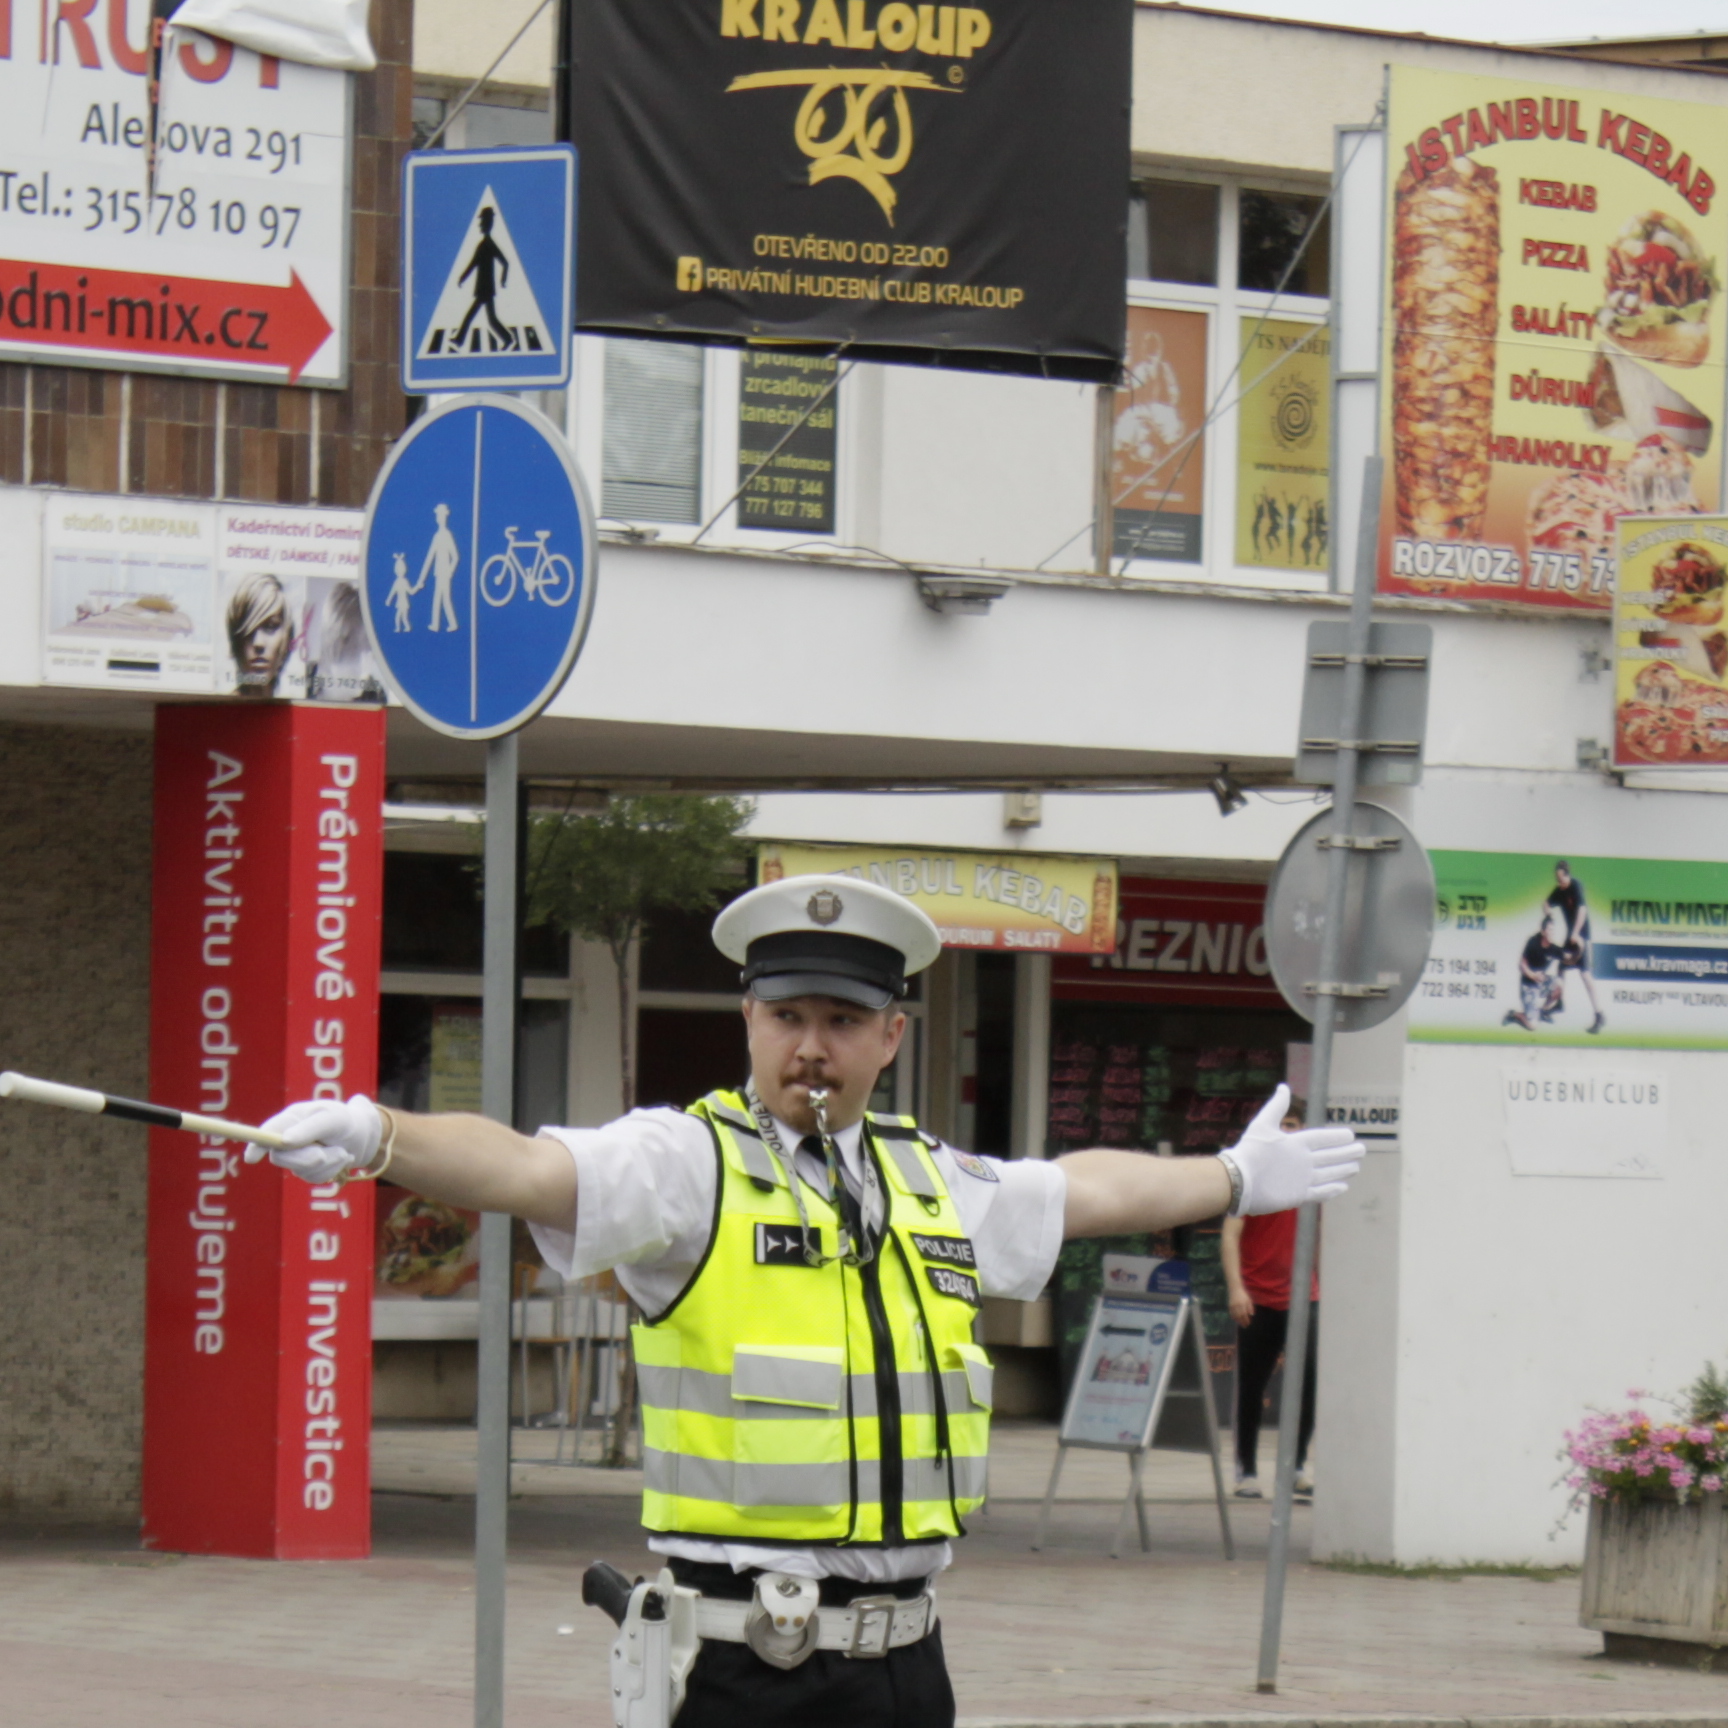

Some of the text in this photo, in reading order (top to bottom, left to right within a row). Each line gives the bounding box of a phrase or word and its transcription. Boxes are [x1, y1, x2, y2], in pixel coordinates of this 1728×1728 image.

[721, 0, 991, 58] KRALOUP
[81, 102, 302, 175] Aleova 291
[1405, 96, 1716, 216] ISTANBUL KEBAB
[1519, 178, 1597, 213] KEBAB
[84, 187, 141, 234] 315
[155, 188, 196, 235] 78
[210, 200, 245, 234] 10
[259, 204, 301, 249] 97
[753, 233, 949, 268] OTEVŘENO OD 22.00
[1522, 238, 1590, 273] PIZZA
[706, 265, 1024, 309] PRIVÁTNÍ HUDEBNÍ CLUB KRALOUP
[1511, 302, 1597, 340] SALÁTY
[1510, 369, 1595, 409] DÜRUM
[807, 407, 834, 429] sál
[1487, 435, 1613, 474] HRANOLKY
[745, 497, 770, 514] 777
[774, 500, 797, 516] 127
[63, 513, 201, 540] studio CAMPANA
[1394, 539, 1581, 591] ROZVOZ: 775
[202, 750, 245, 967] Aktivitu
[974, 863, 1088, 935] KEBAB
[1610, 900, 1670, 924] KRAV
[1613, 990, 1664, 1005] KRALUPY
[1509, 1078, 1660, 1105] UDEBNÍ CLUB
[303, 753, 359, 1511] Prémiové sponí a investice
[1326, 1107, 1399, 1124] KRALOUP
[914, 1236, 974, 1263] POLICIE
